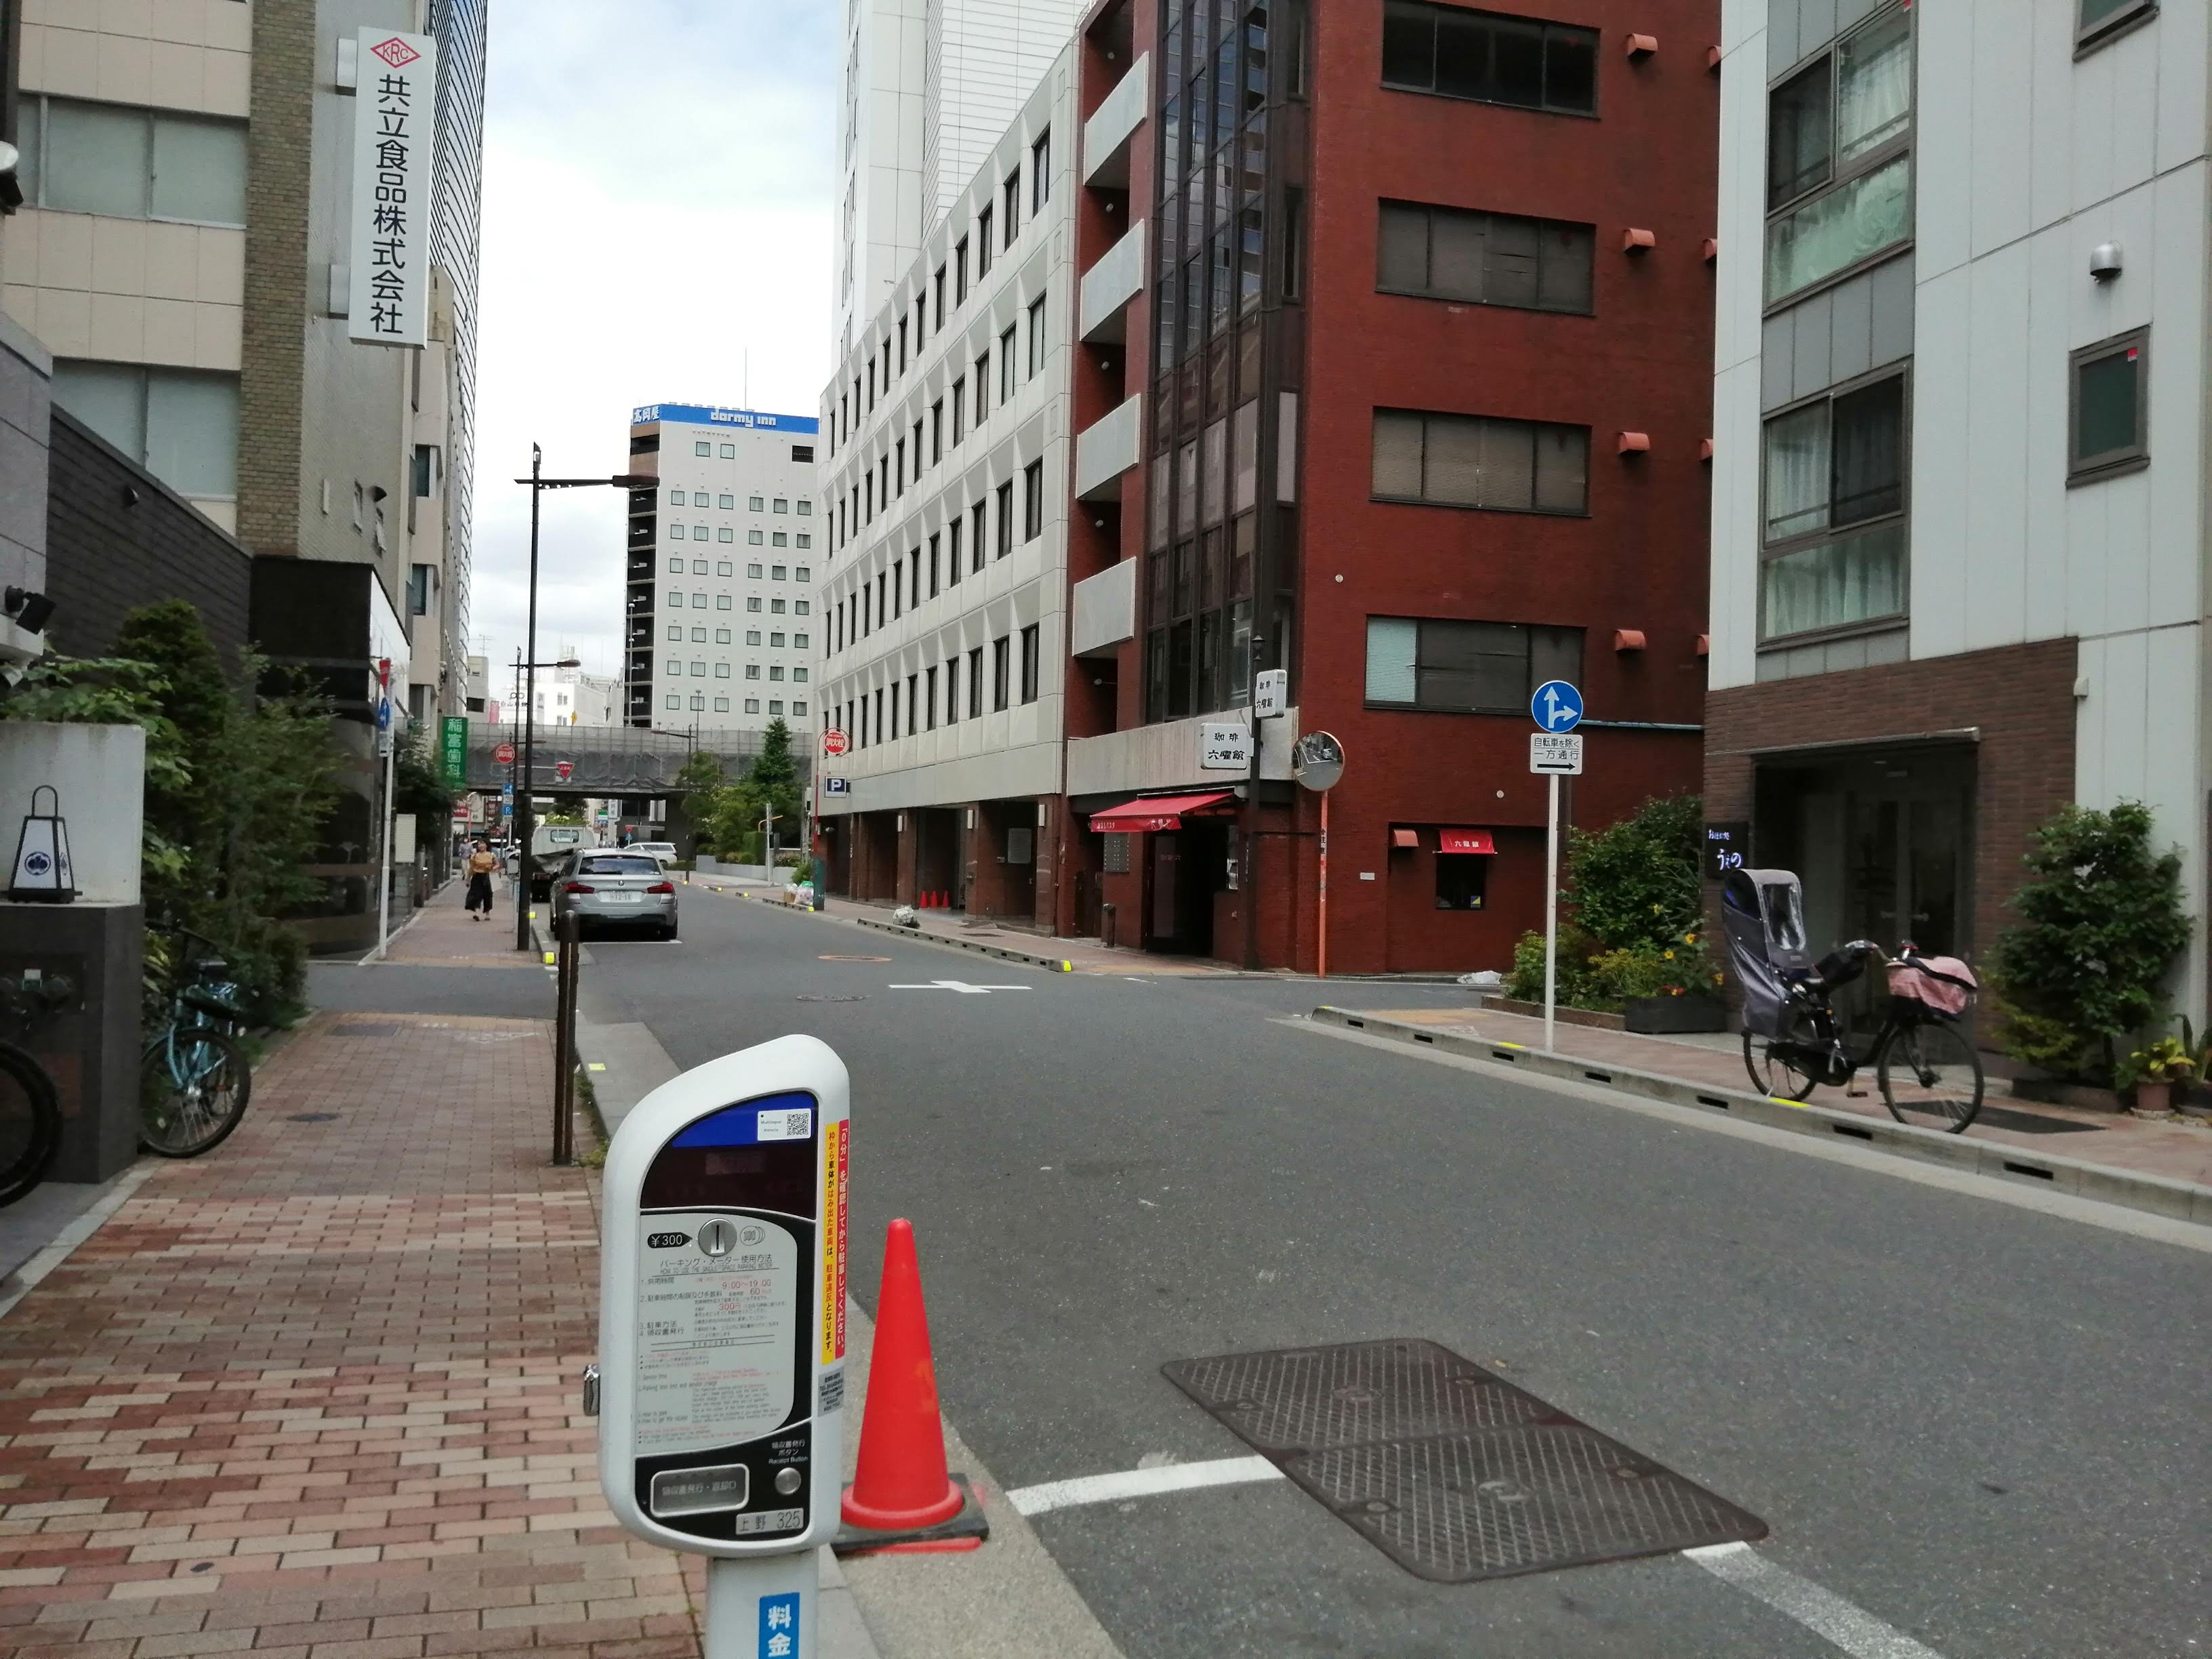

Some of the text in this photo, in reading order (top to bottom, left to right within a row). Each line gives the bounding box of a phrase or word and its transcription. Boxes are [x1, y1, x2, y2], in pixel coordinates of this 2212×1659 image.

[382, 42, 409, 63] KRC
[370, 73, 411, 335] 共立食品株式会社
[710, 407, 777, 428] dormy inn
[1214, 732, 1239, 743] 珈琲
[1534, 737, 1580, 748] 自転車を除く
[1208, 750, 1246, 760] 六曜館
[1534, 749, 1580, 760] 一方通行
[831, 779, 842, 792] P
[651, 1234, 683, 1247] ¥300
[741, 1511, 801, 1532] 上野 325
[768, 1603, 792, 1658] 料金
